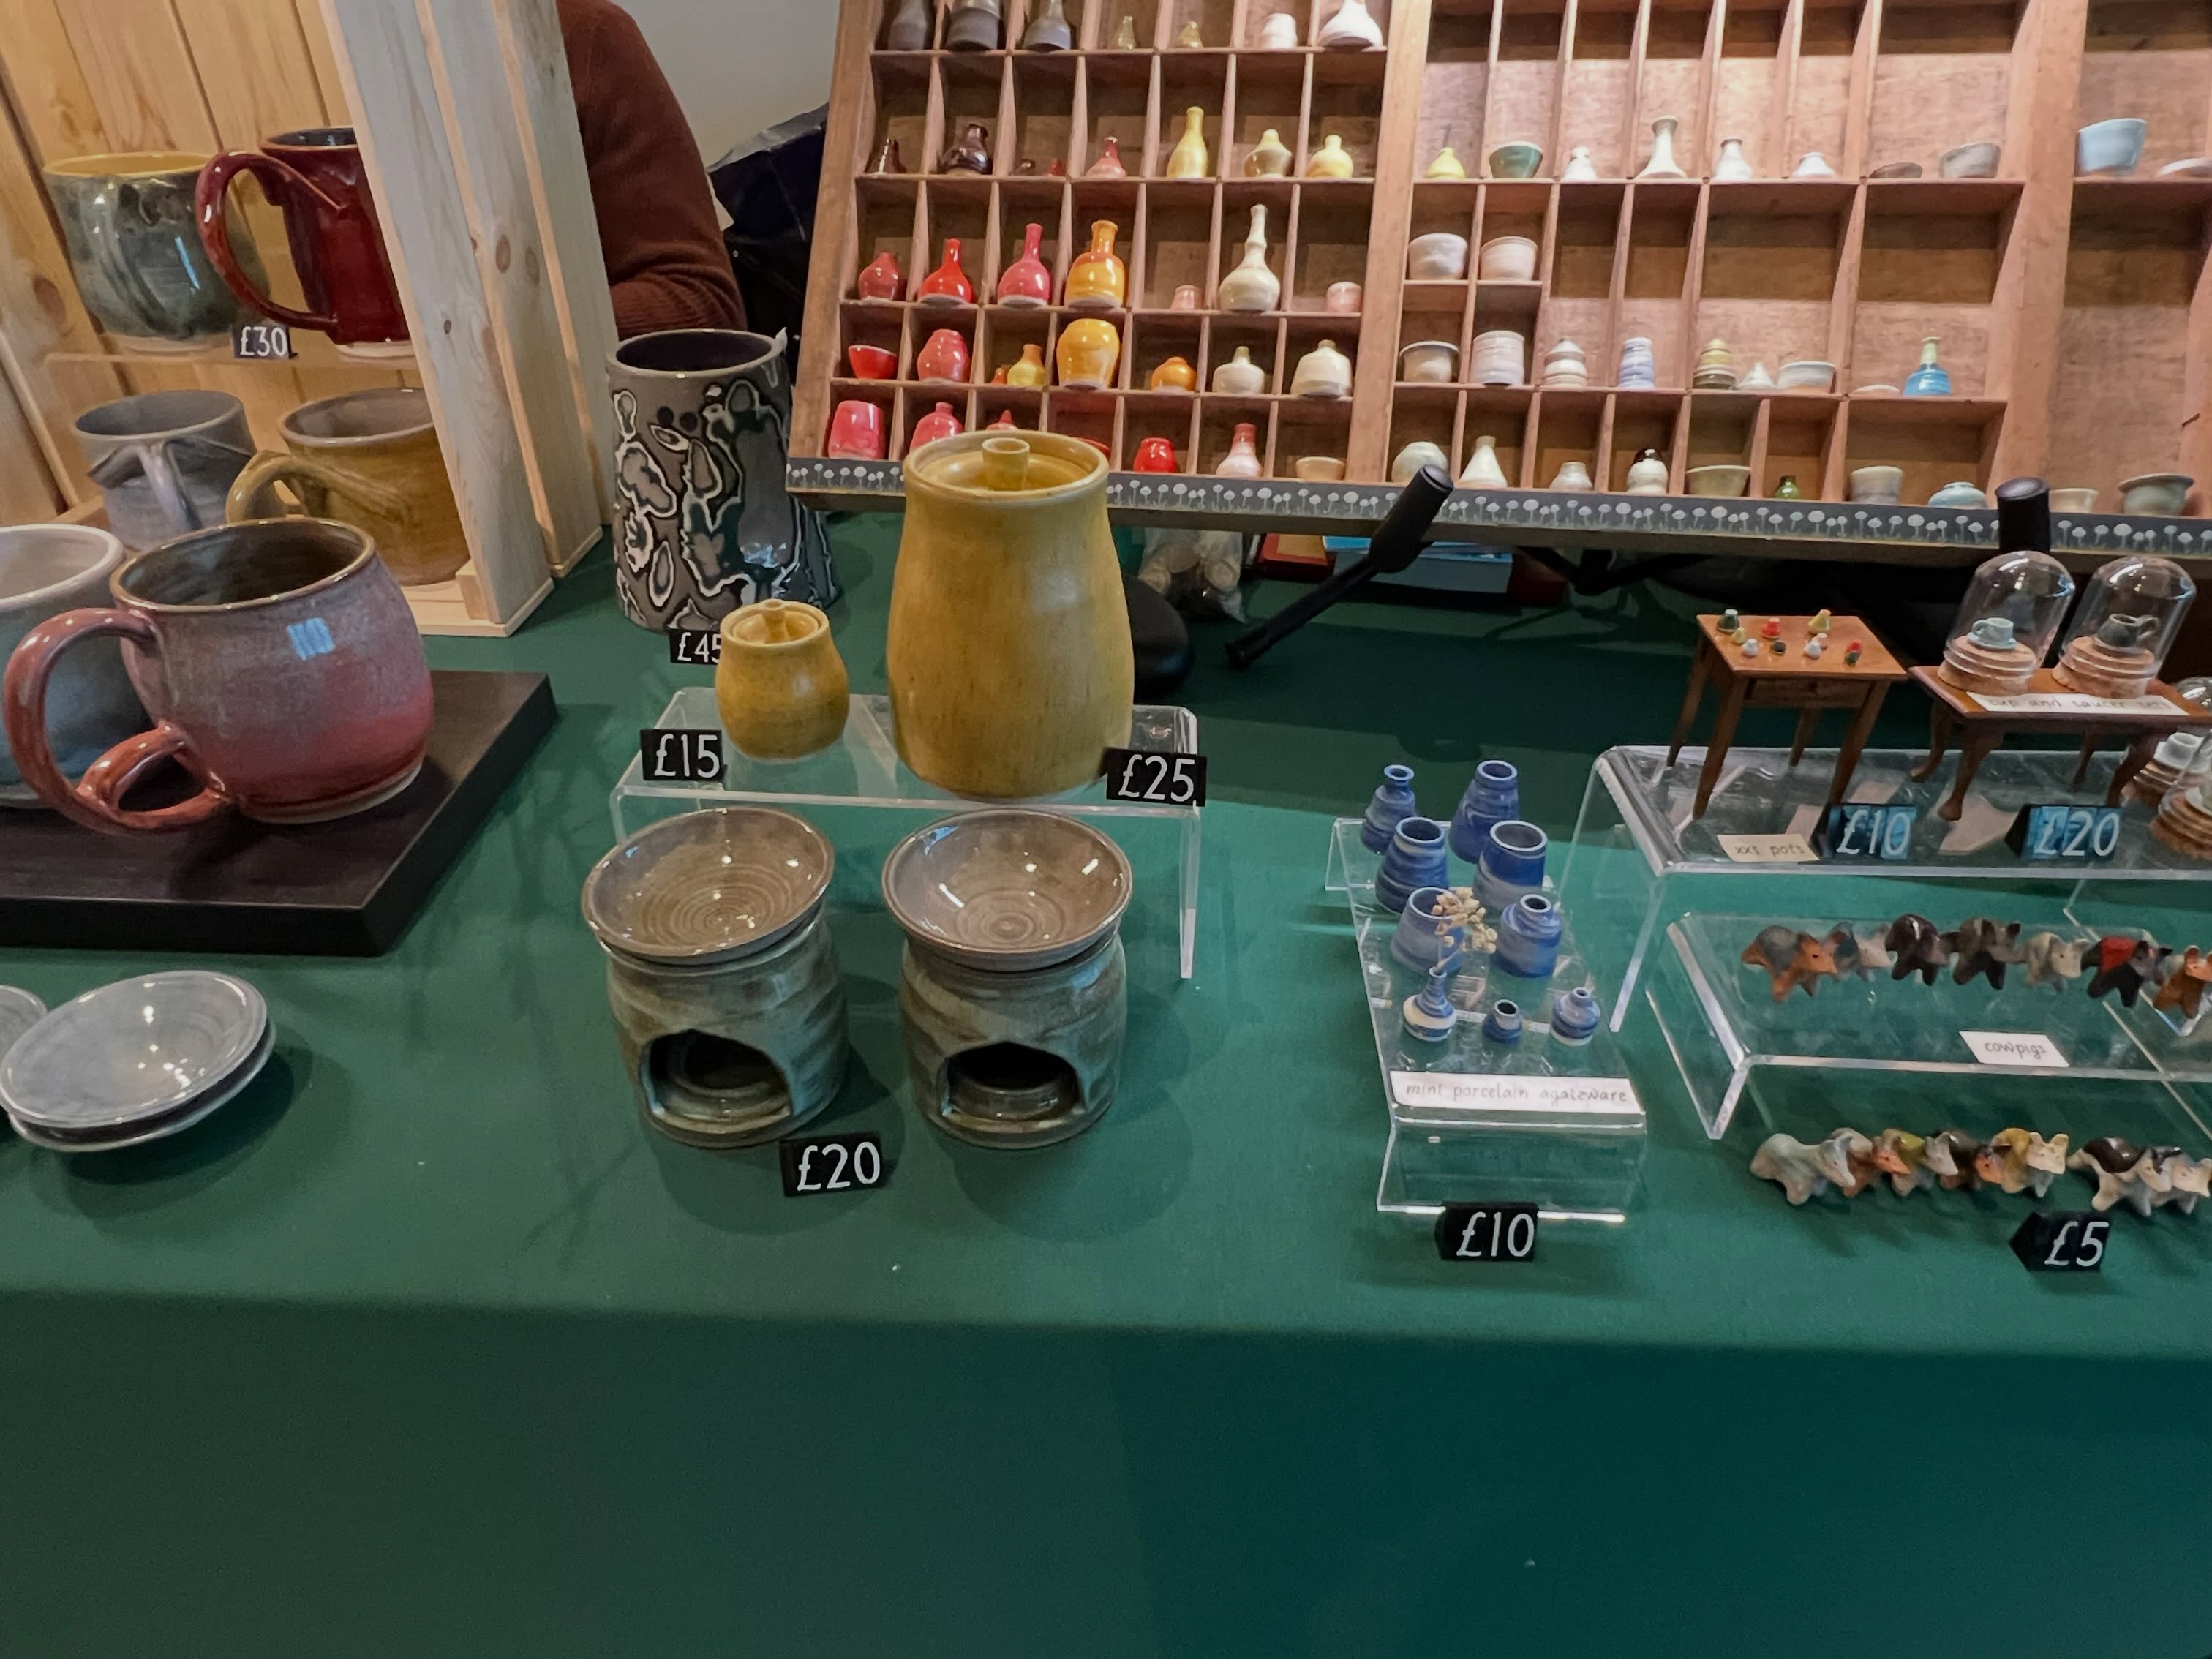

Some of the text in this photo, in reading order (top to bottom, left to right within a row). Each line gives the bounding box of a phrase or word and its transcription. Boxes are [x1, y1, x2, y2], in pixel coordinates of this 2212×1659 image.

[240, 326, 288, 357] £30
[677, 631, 721, 663] £45
[2028, 696, 2062, 708] and
[654, 733, 720, 778] £15
[1118, 753, 1195, 802] £25
[1734, 843, 1805, 858] xxs pots
[1836, 809, 1911, 855] £10
[2034, 810, 2120, 857] £20
[1405, 1082, 1627, 1106] mint porcelain agateware
[797, 1141, 881, 1192] £20
[1456, 1211, 1535, 1257] £10
[2044, 1220, 2110, 1267] £5
